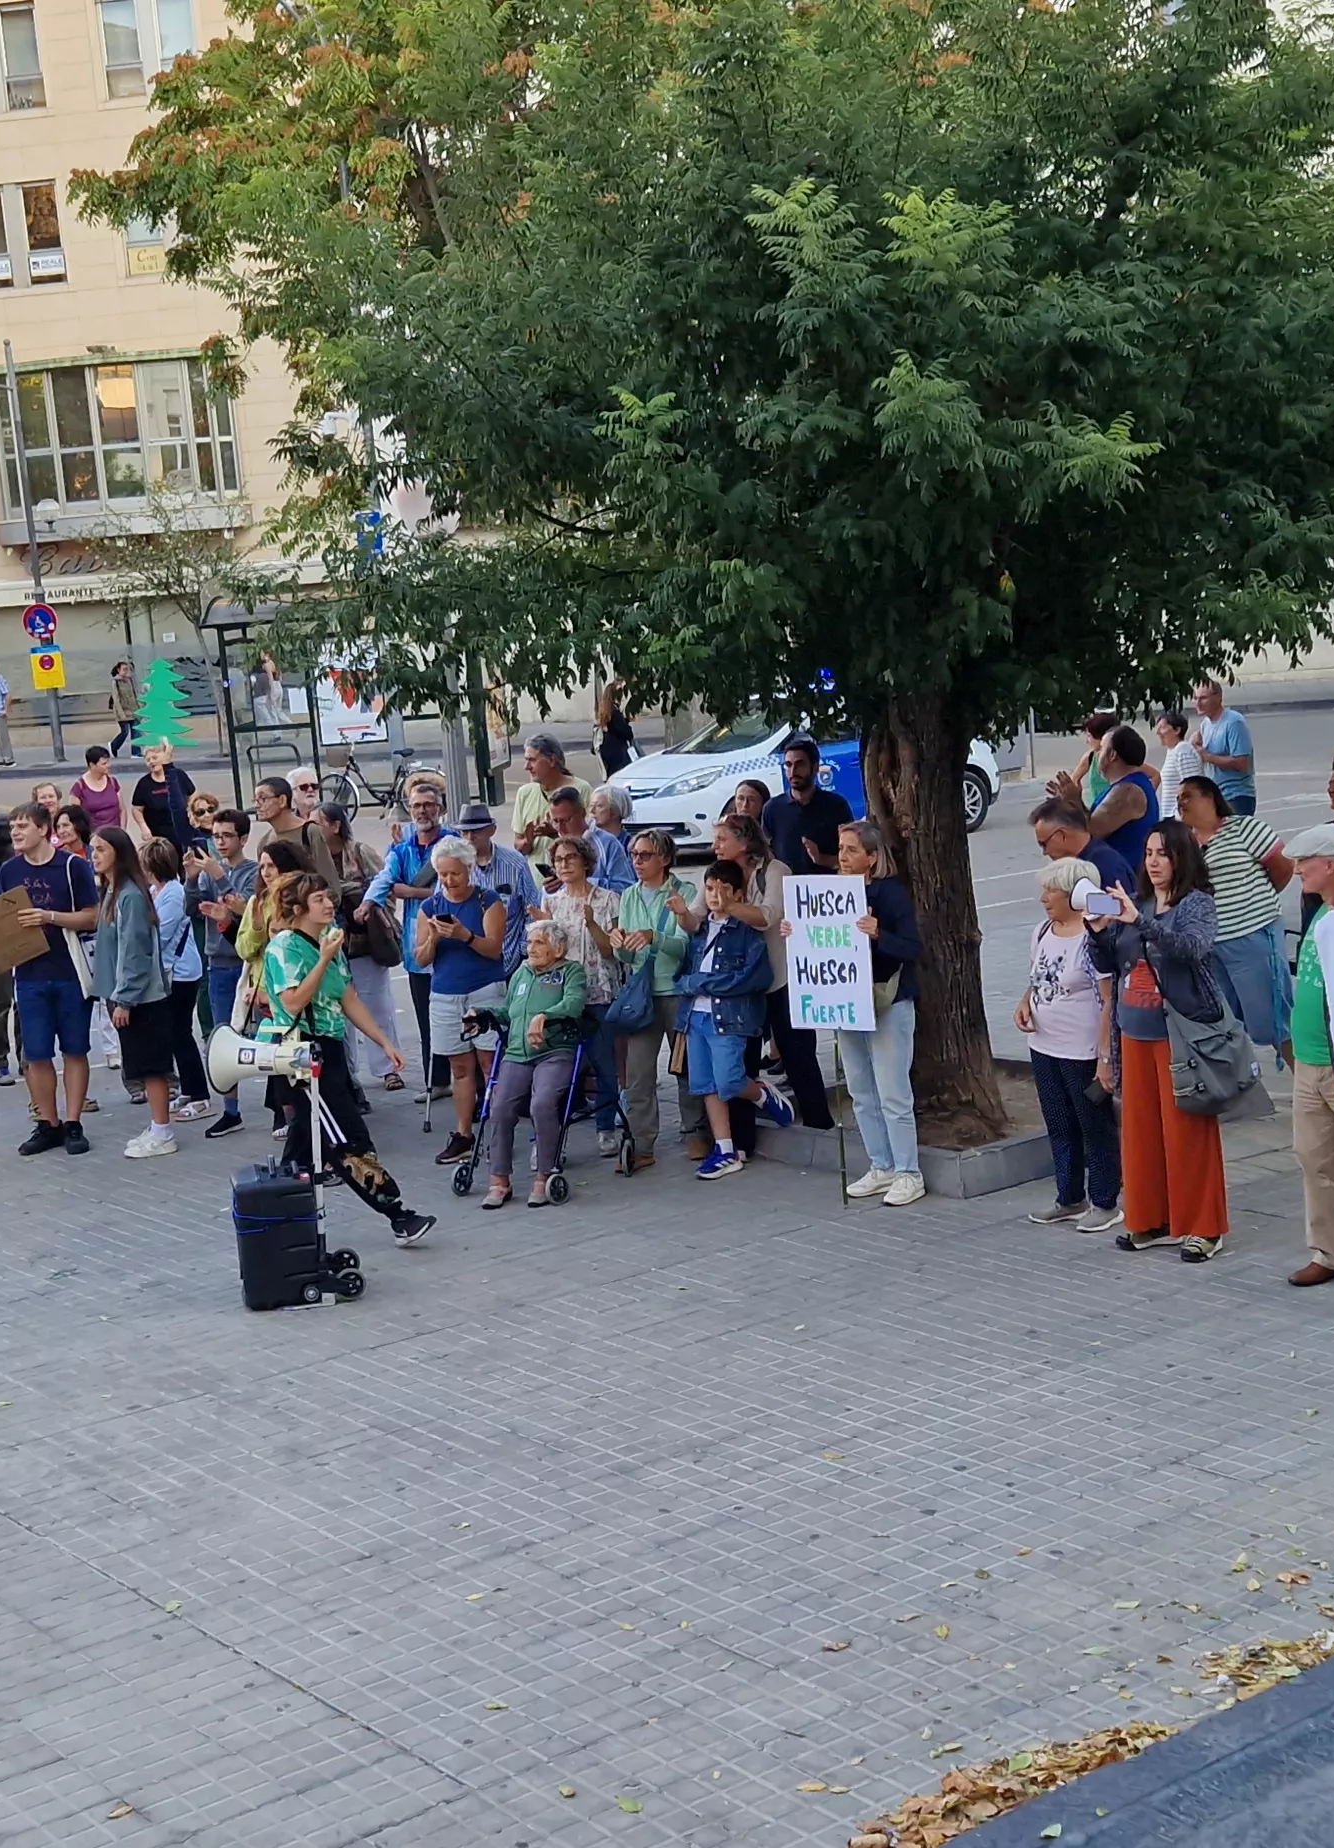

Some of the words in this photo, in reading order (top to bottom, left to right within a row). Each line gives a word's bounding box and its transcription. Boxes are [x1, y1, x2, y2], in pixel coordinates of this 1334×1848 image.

[795, 884, 857, 920] HUESCA
[805, 923, 858, 952] VERDE,
[795, 956, 857, 986] HUESCA
[800, 994, 856, 1025] FUERTE
